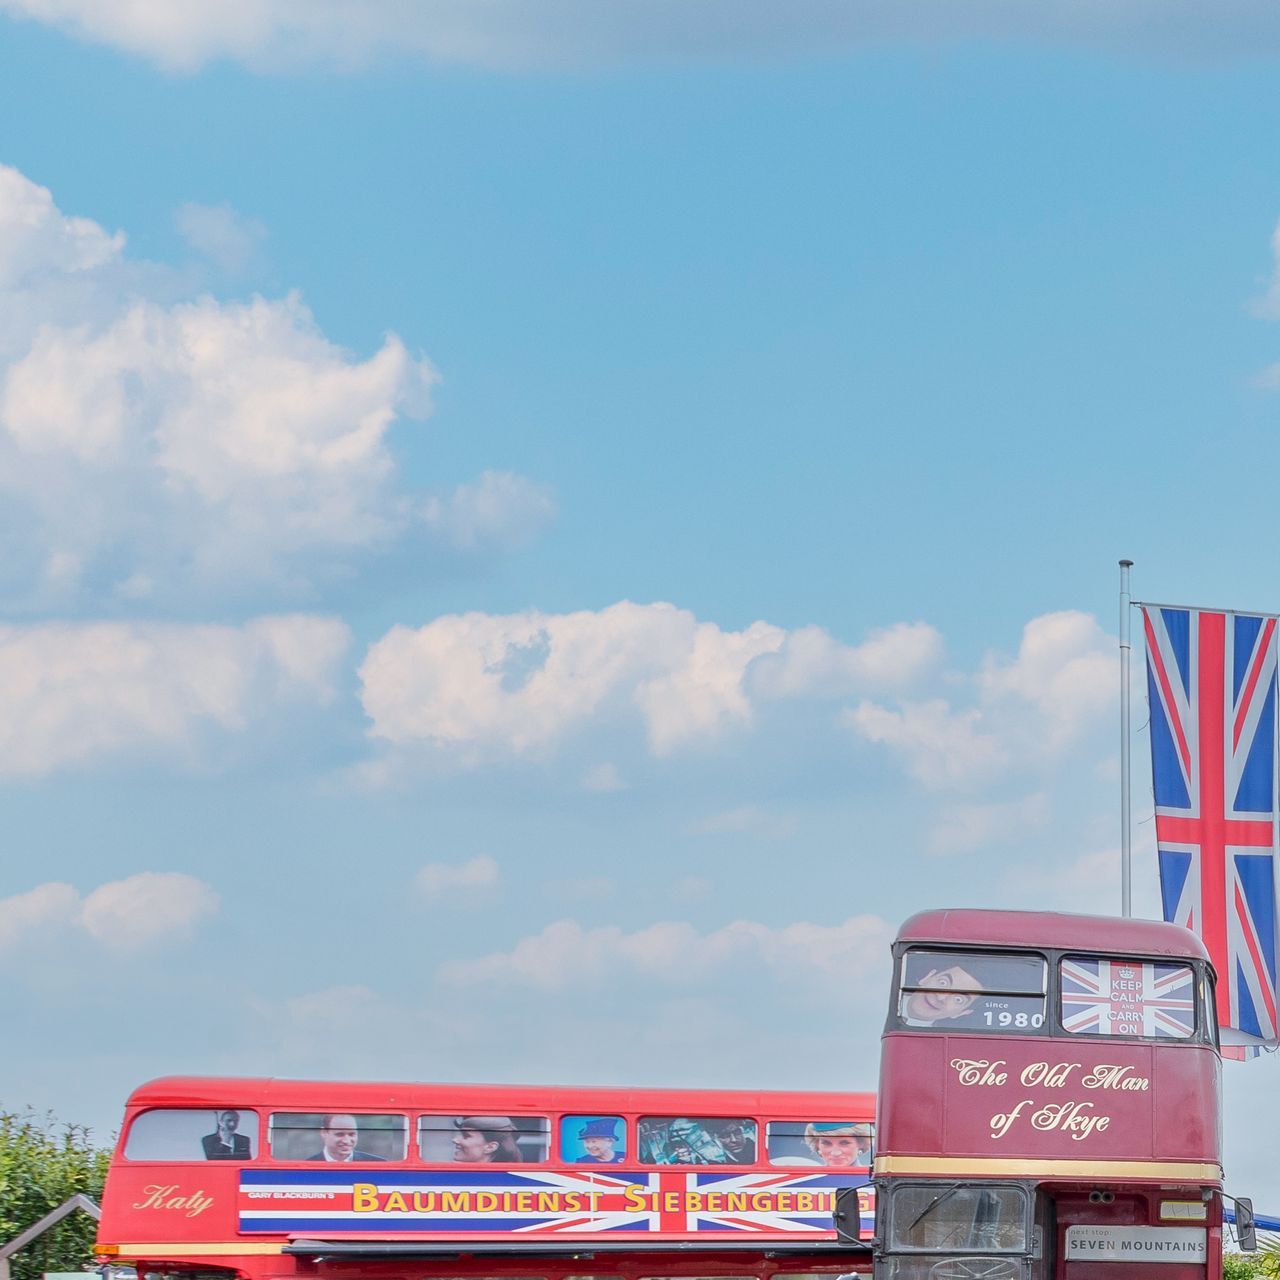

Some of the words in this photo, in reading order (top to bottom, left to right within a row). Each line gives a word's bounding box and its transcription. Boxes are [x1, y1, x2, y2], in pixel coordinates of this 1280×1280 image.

[1112, 980, 1143, 991] KEEP
[1110, 991, 1145, 1003] CALM
[985, 1001, 1009, 1009] since
[983, 1011, 1044, 1029] 1980
[1108, 1010, 1145, 1022] CARRY
[1119, 1023, 1137, 1034] ON
[950, 1058, 1008, 1087] The
[1020, 1062, 1081, 1089] Old
[1082, 1064, 1150, 1091] Man
[990, 1100, 1033, 1139] of
[1031, 1101, 1110, 1141] Skye
[132, 1184, 215, 1218] Katy
[352, 1182, 604, 1213] BAUMDIENST
[623, 1184, 870, 1213] SIEBENGEBIG
[1091, 1229, 1112, 1237] stop:
[1071, 1240, 1115, 1250] SEVEN
[1121, 1240, 1205, 1252] MOUNTAINS
